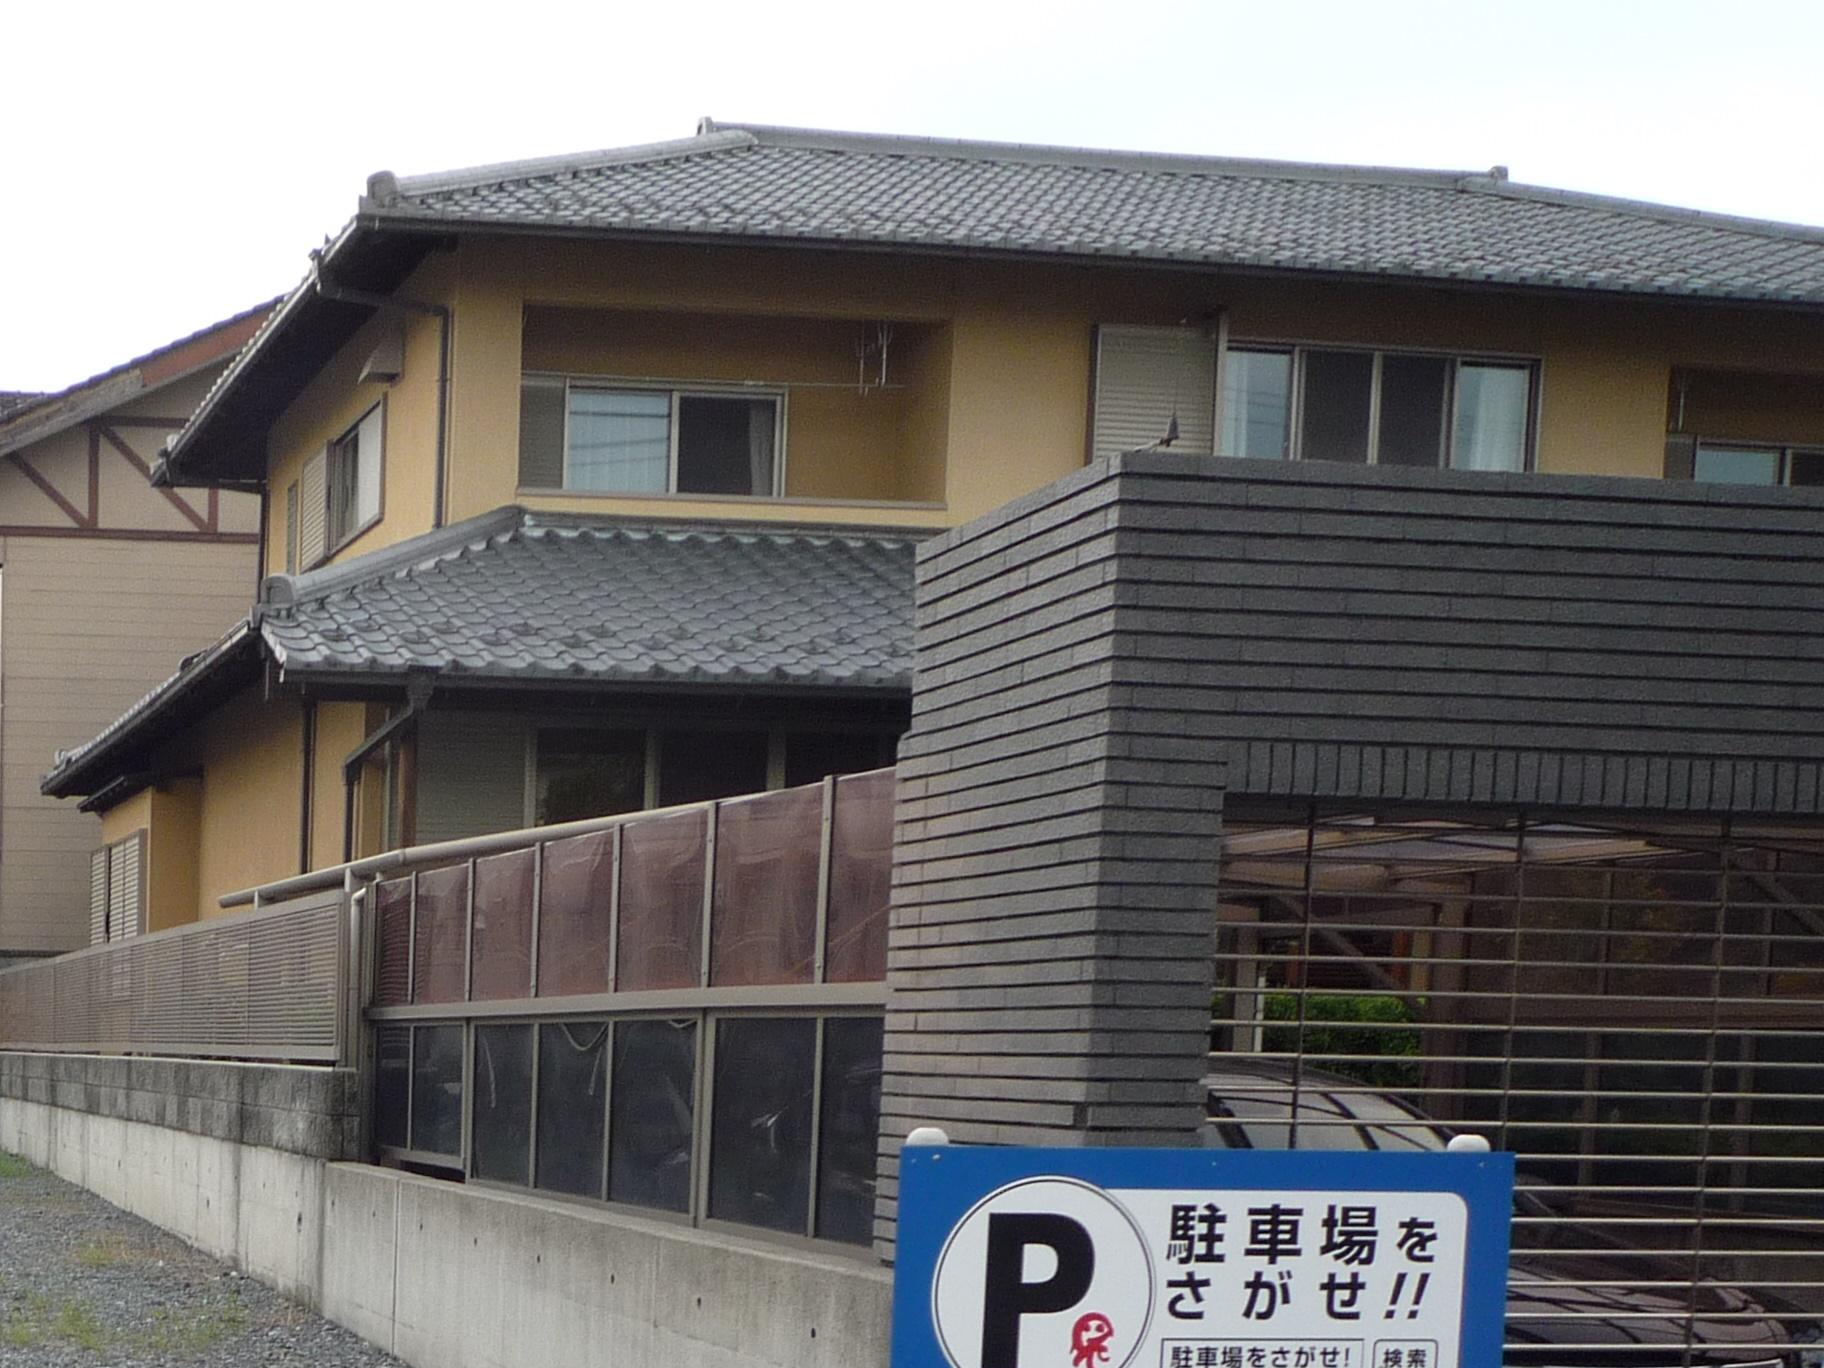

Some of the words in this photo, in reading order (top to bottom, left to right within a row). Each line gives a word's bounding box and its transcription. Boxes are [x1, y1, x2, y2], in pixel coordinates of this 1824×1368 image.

[1167, 1203, 1438, 1265] 駐車場を
[1167, 1271, 1431, 1320] さがせ!!
[1170, 1346, 1350, 1368] 駐車場をさがせ!
[1383, 1348, 1427, 1368] 検索
